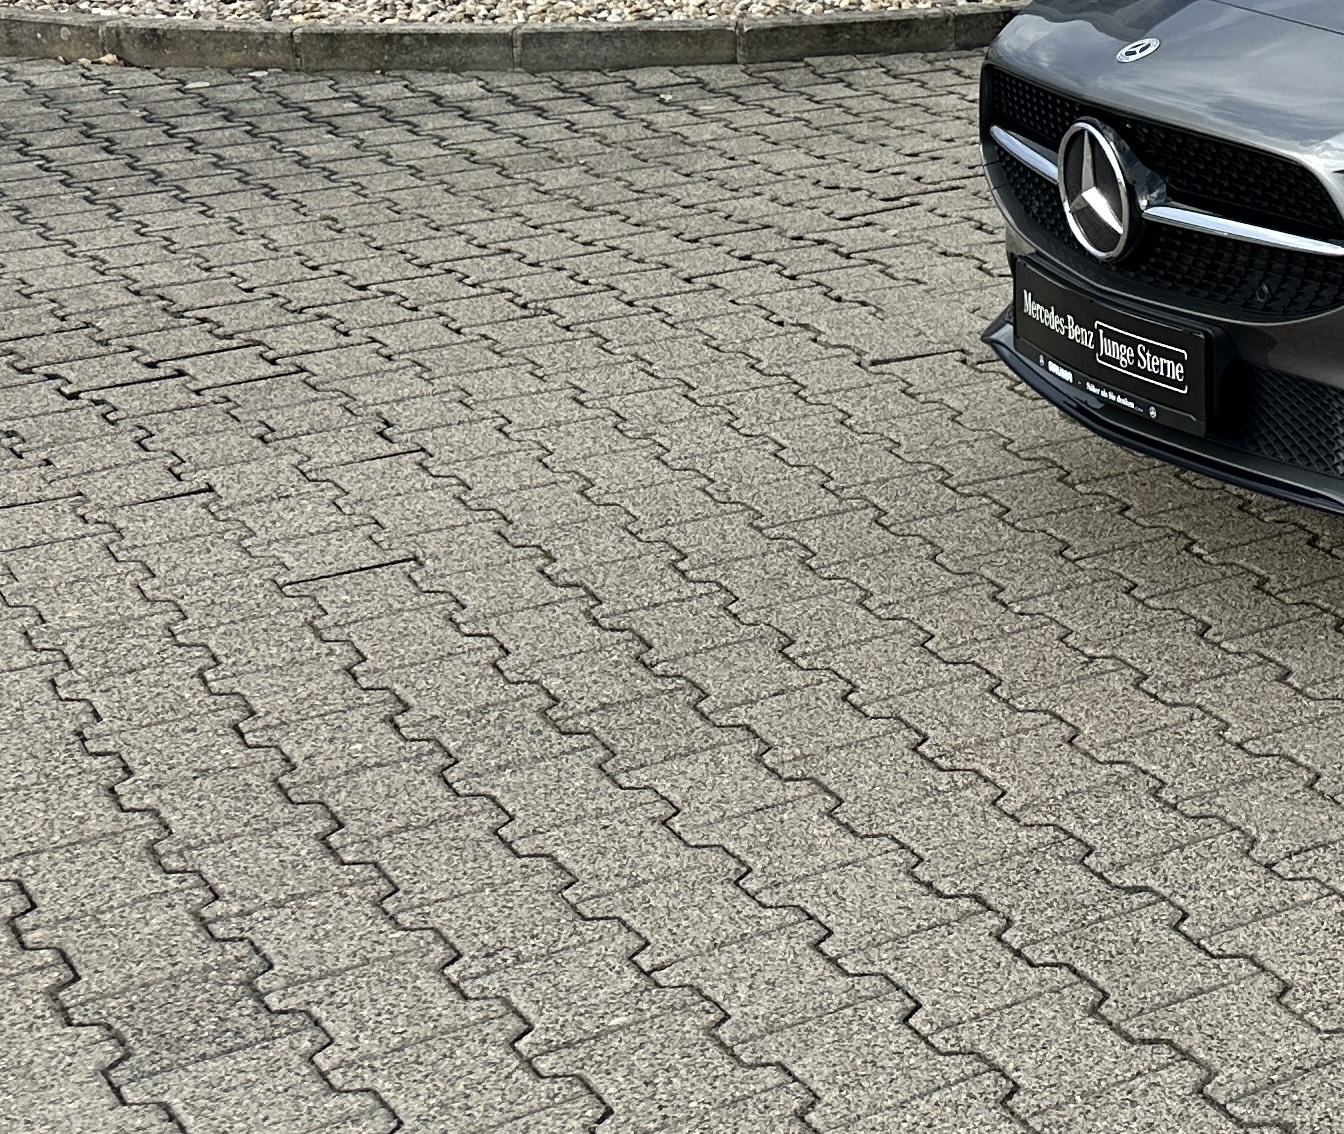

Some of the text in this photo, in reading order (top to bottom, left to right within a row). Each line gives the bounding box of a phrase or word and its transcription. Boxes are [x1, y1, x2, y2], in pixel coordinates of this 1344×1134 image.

[1023, 289, 1185, 382] Mercedes-Benz Junge Sterne
